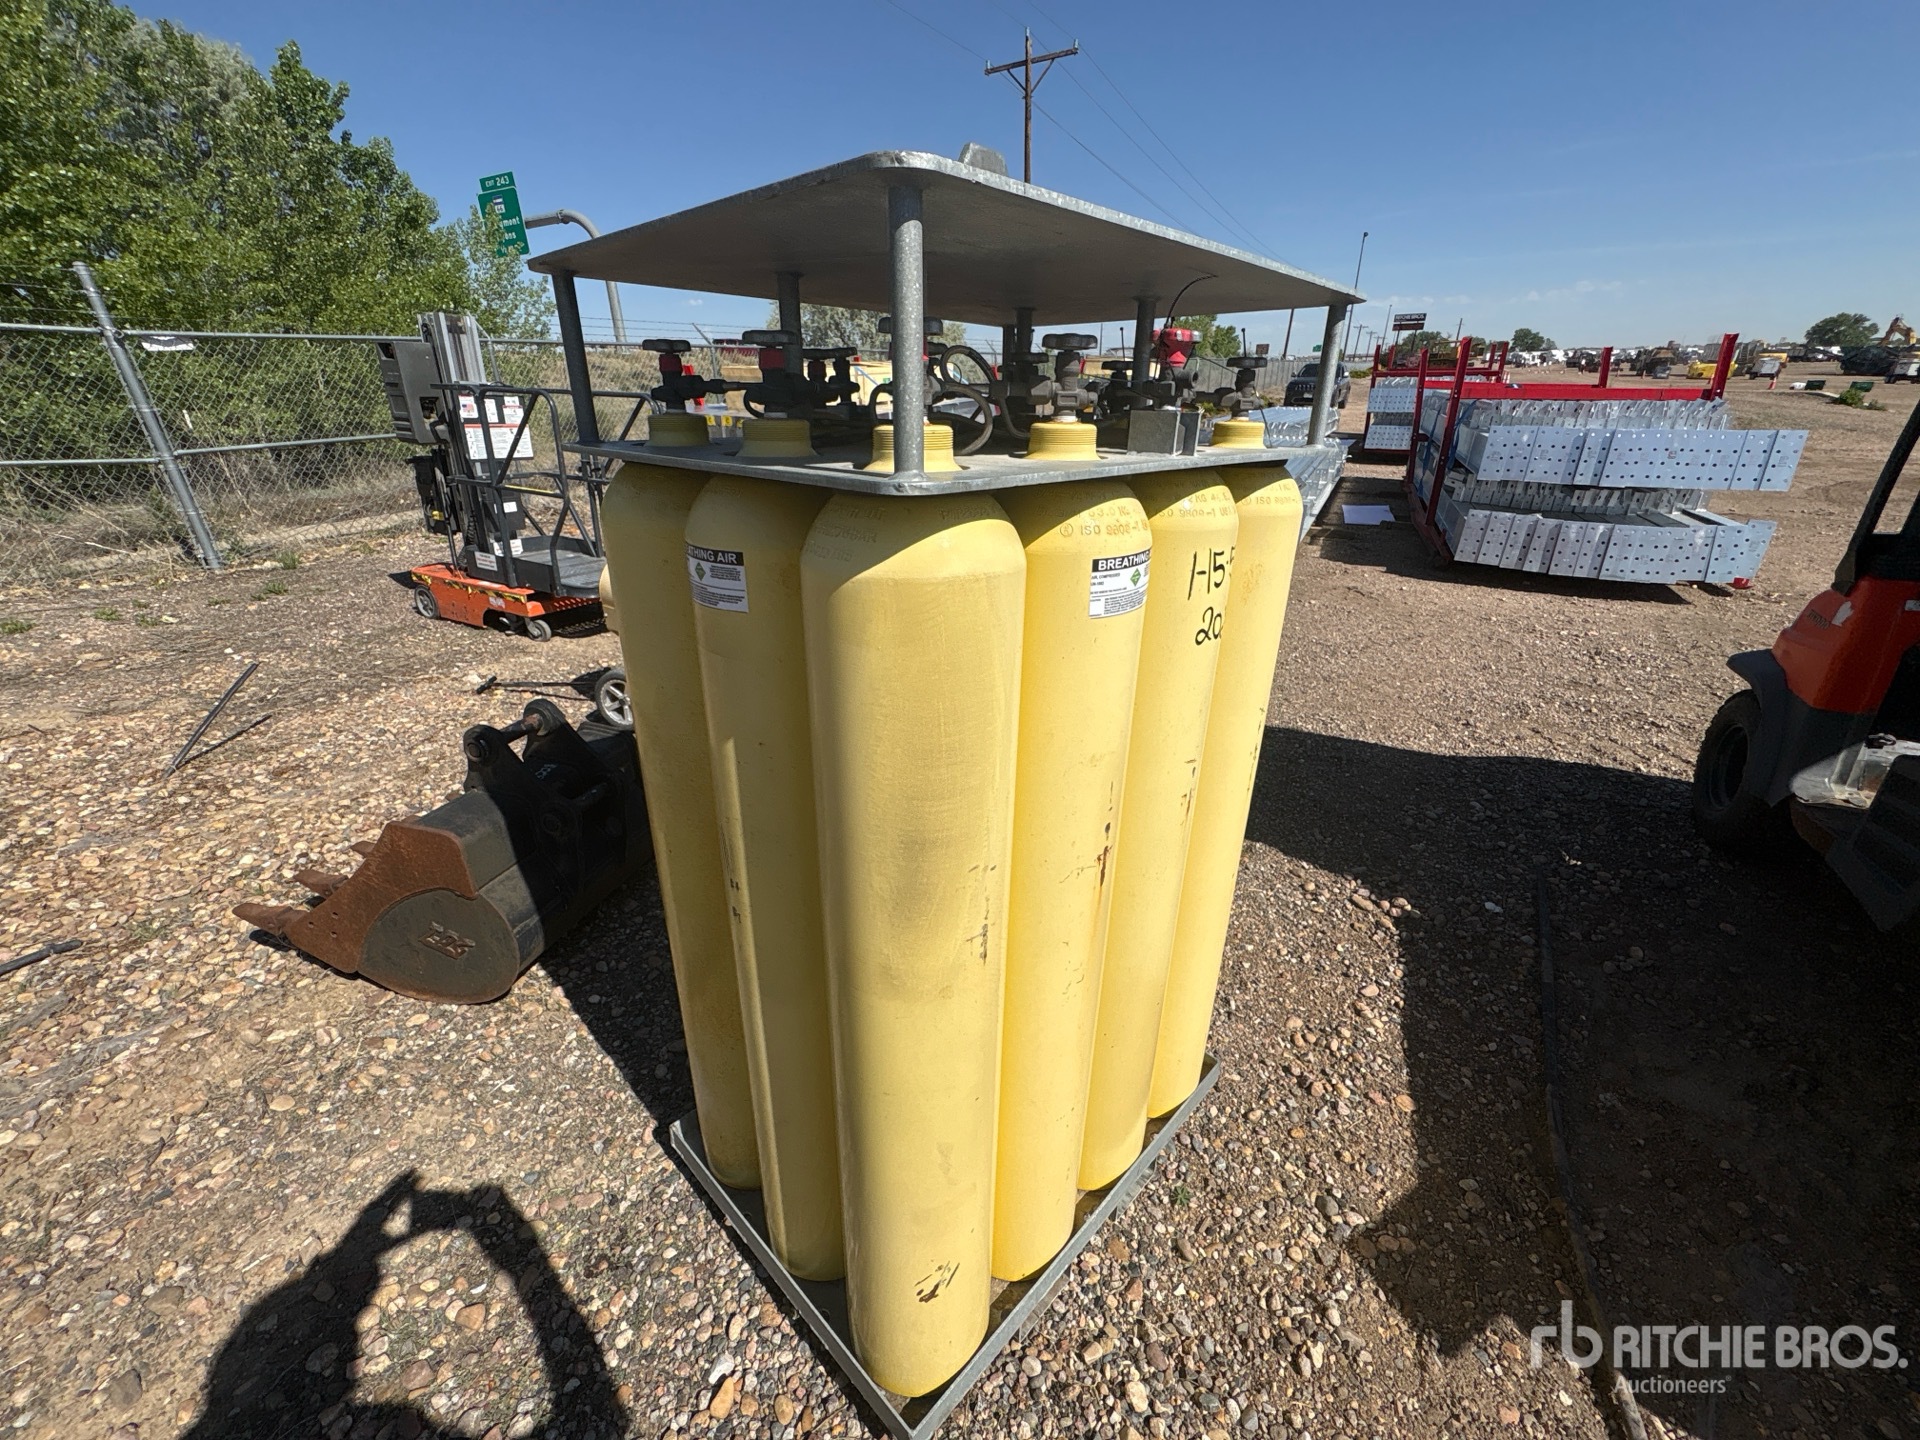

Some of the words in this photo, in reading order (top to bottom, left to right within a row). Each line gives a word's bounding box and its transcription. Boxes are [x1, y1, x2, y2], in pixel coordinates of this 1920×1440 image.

[496, 176, 509, 186] 243
[1080, 524, 1101, 536] ISO
[717, 552, 738, 564] AIR
